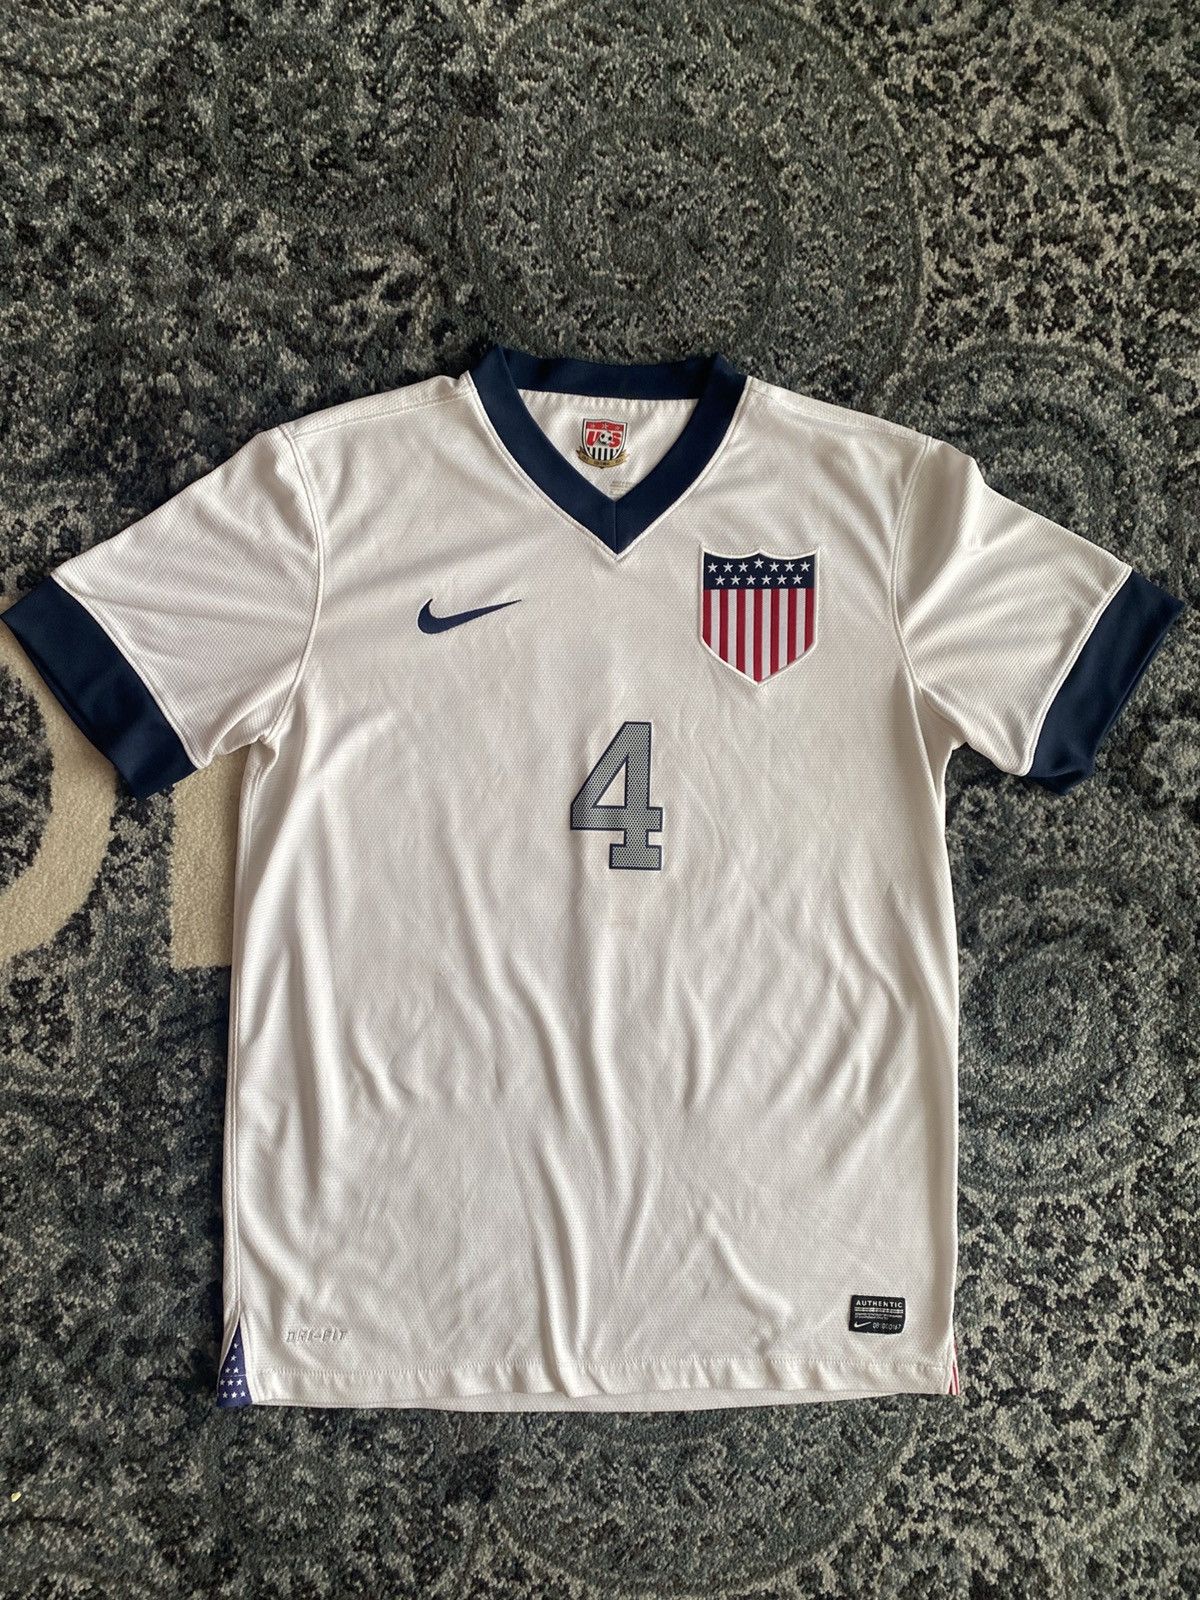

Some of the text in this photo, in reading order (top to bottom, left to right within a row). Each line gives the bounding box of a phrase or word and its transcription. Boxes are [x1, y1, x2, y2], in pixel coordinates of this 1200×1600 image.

[586, 430, 623, 448] US
[570, 721, 663, 870] 4
[855, 1299, 904, 1309] AUTHENTIC
[286, 1329, 348, 1343] DRI-FIT
